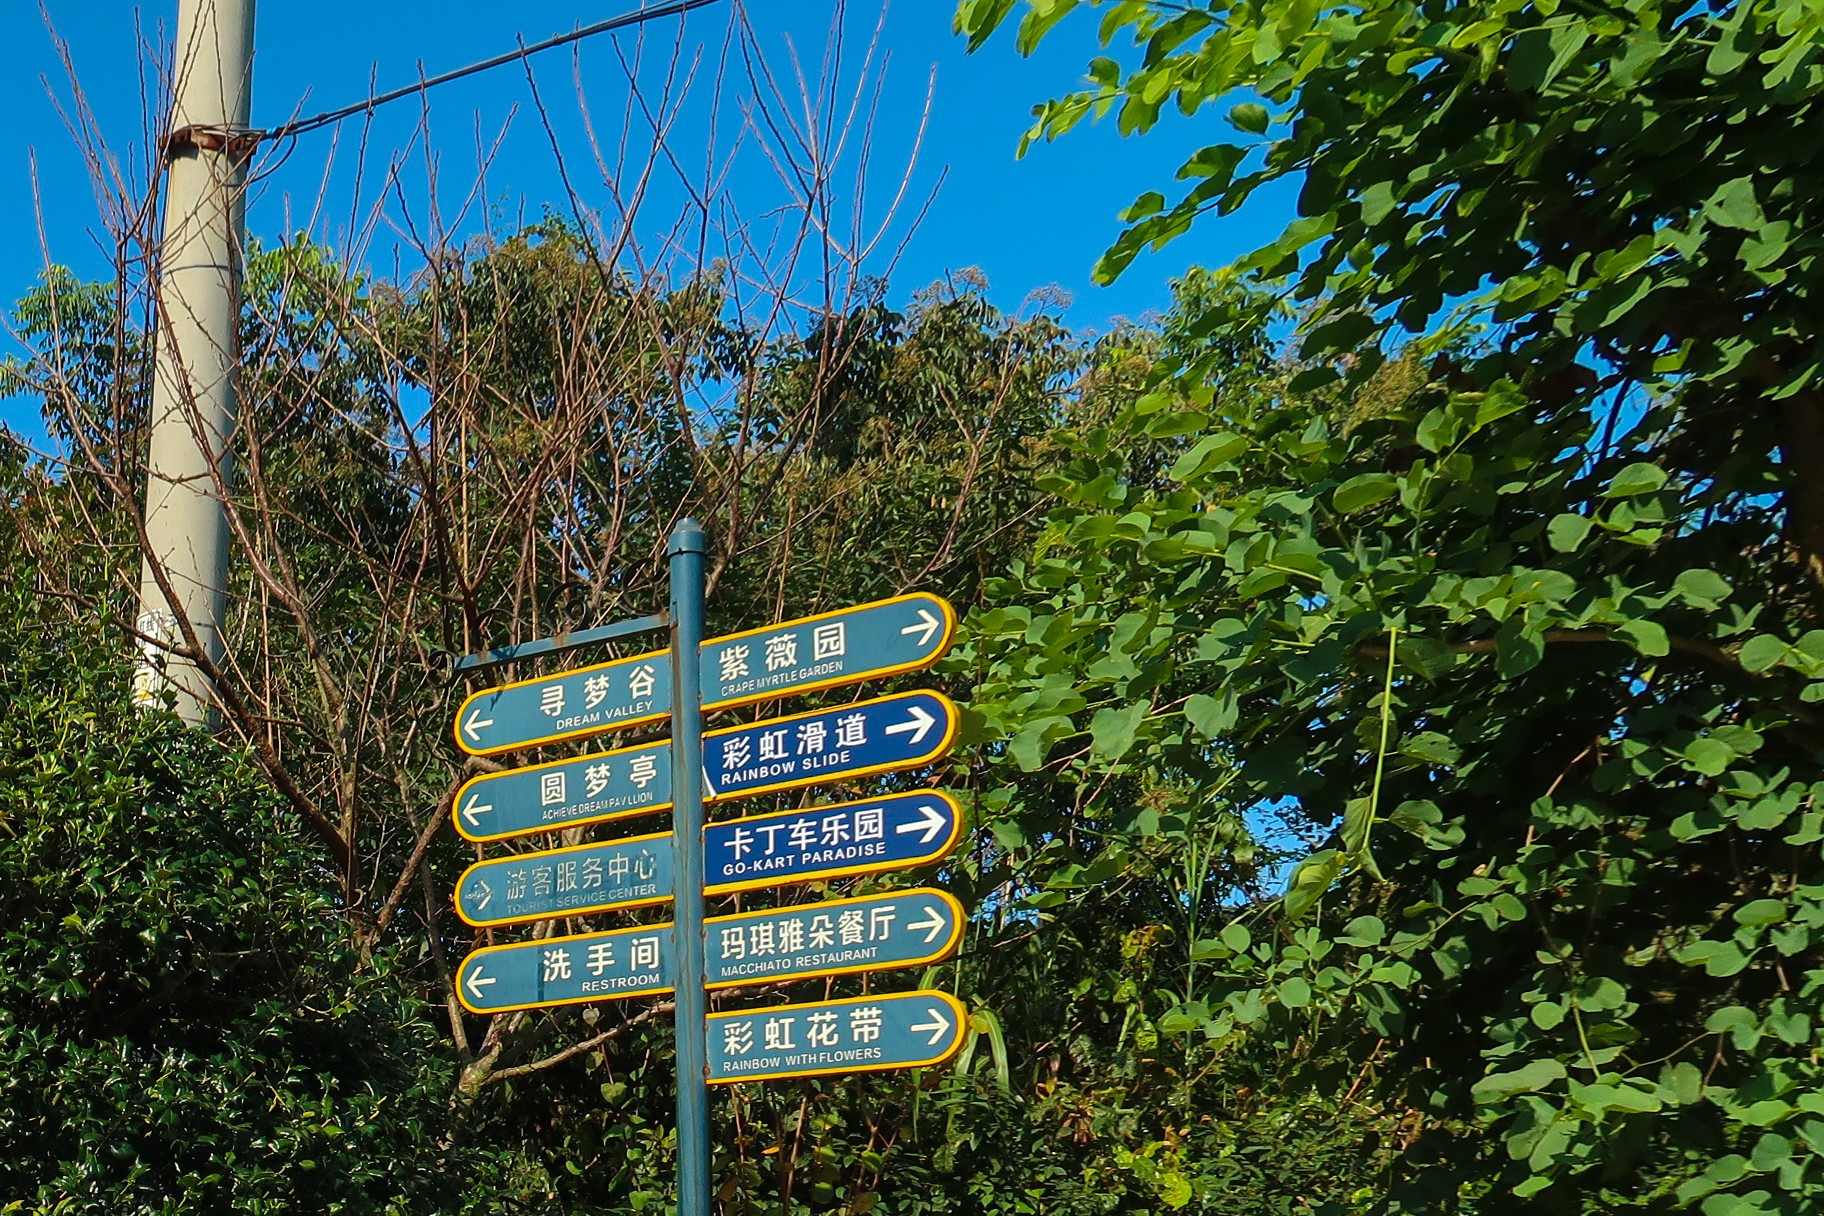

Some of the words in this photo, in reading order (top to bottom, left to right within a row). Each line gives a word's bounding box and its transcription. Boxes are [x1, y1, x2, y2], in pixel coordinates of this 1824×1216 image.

[719, 622, 845, 682] 紫薇园
[540, 665, 655, 716] 寻梦谷
[721, 679, 755, 697] CRAPE
[757, 670, 797, 689] MYRTLE
[799, 661, 843, 680] GARDEN
[556, 712, 600, 730] DREAM
[605, 700, 653, 719] VALLEY
[722, 712, 867, 770] 彩虹滑道
[541, 755, 657, 806] 圆梦亭
[721, 761, 795, 785] RAINBOW
[802, 750, 851, 770] SLIDE
[542, 804, 577, 820] ACHIEVE
[578, 799, 607, 814] DREAM
[609, 792, 653, 808] PAVLLION
[723, 807, 884, 860] 卡丁车乐园
[507, 849, 656, 900] 游客服务中心
[723, 855, 795, 876] GO-KART
[801, 842, 886, 865] PARADISE
[507, 898, 553, 915] TOURIST
[557, 890, 605, 907] SERVICE
[609, 884, 656, 900] CENTER
[721, 905, 896, 960] 玛琪雅朵餐厅
[543, 936, 659, 982] 洗手间
[721, 958, 791, 977] MACCHIATO
[795, 946, 878, 967] RESTAURANT
[582, 973, 660, 992] RESTROOM
[723, 1006, 883, 1056] 彩虹花带
[723, 1057, 780, 1072] RAINBOW
[785, 1053, 817, 1066] WITH
[819, 1047, 882, 1063] FLOWERS
